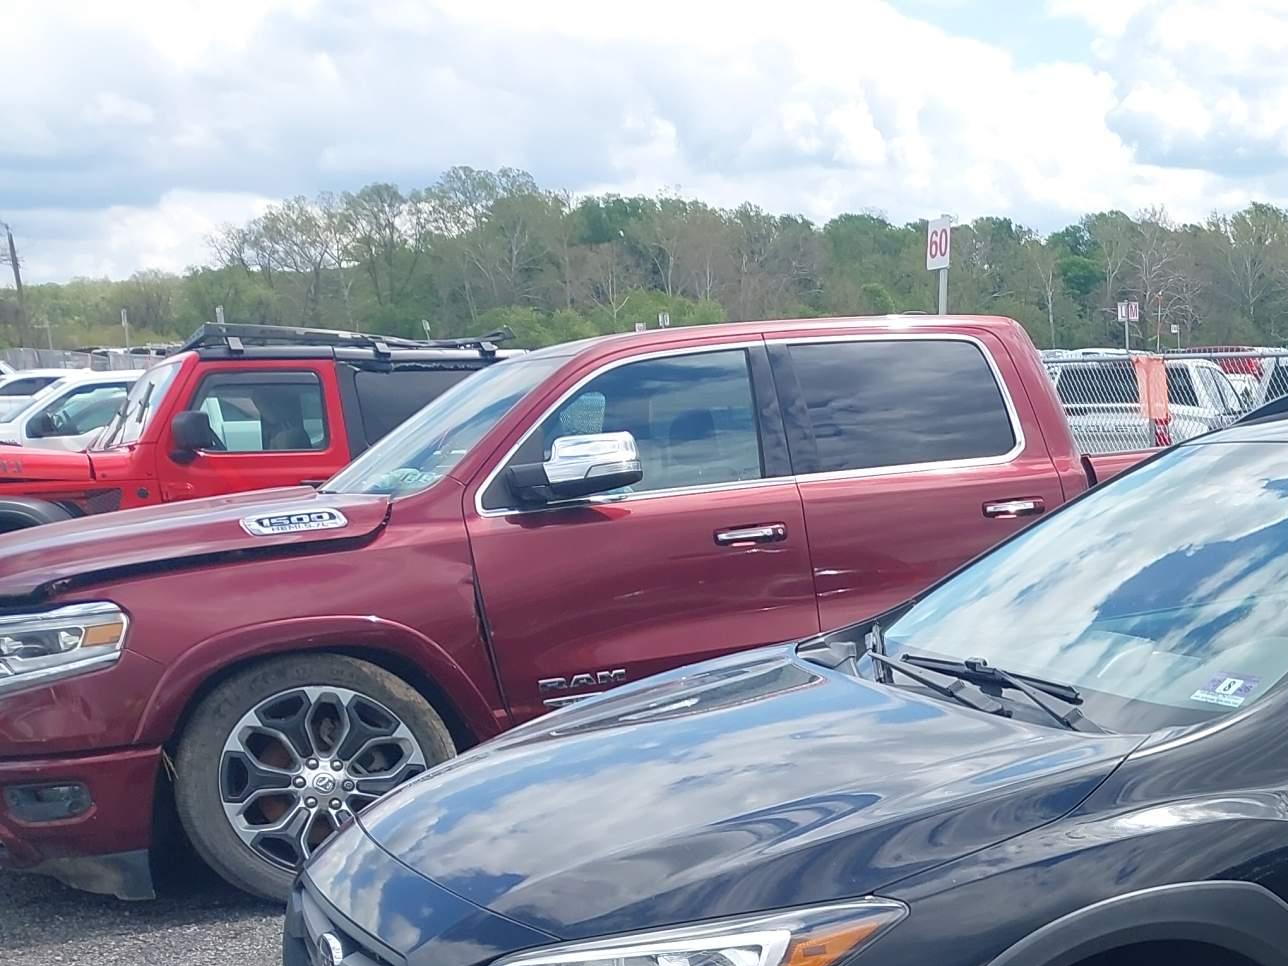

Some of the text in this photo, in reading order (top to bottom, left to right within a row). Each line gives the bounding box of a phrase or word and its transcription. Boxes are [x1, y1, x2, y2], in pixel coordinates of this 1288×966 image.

[930, 229, 948, 258] 60
[1129, 304, 1138, 318] M
[262, 512, 330, 528] 1500
[538, 669, 626, 689] RAM
